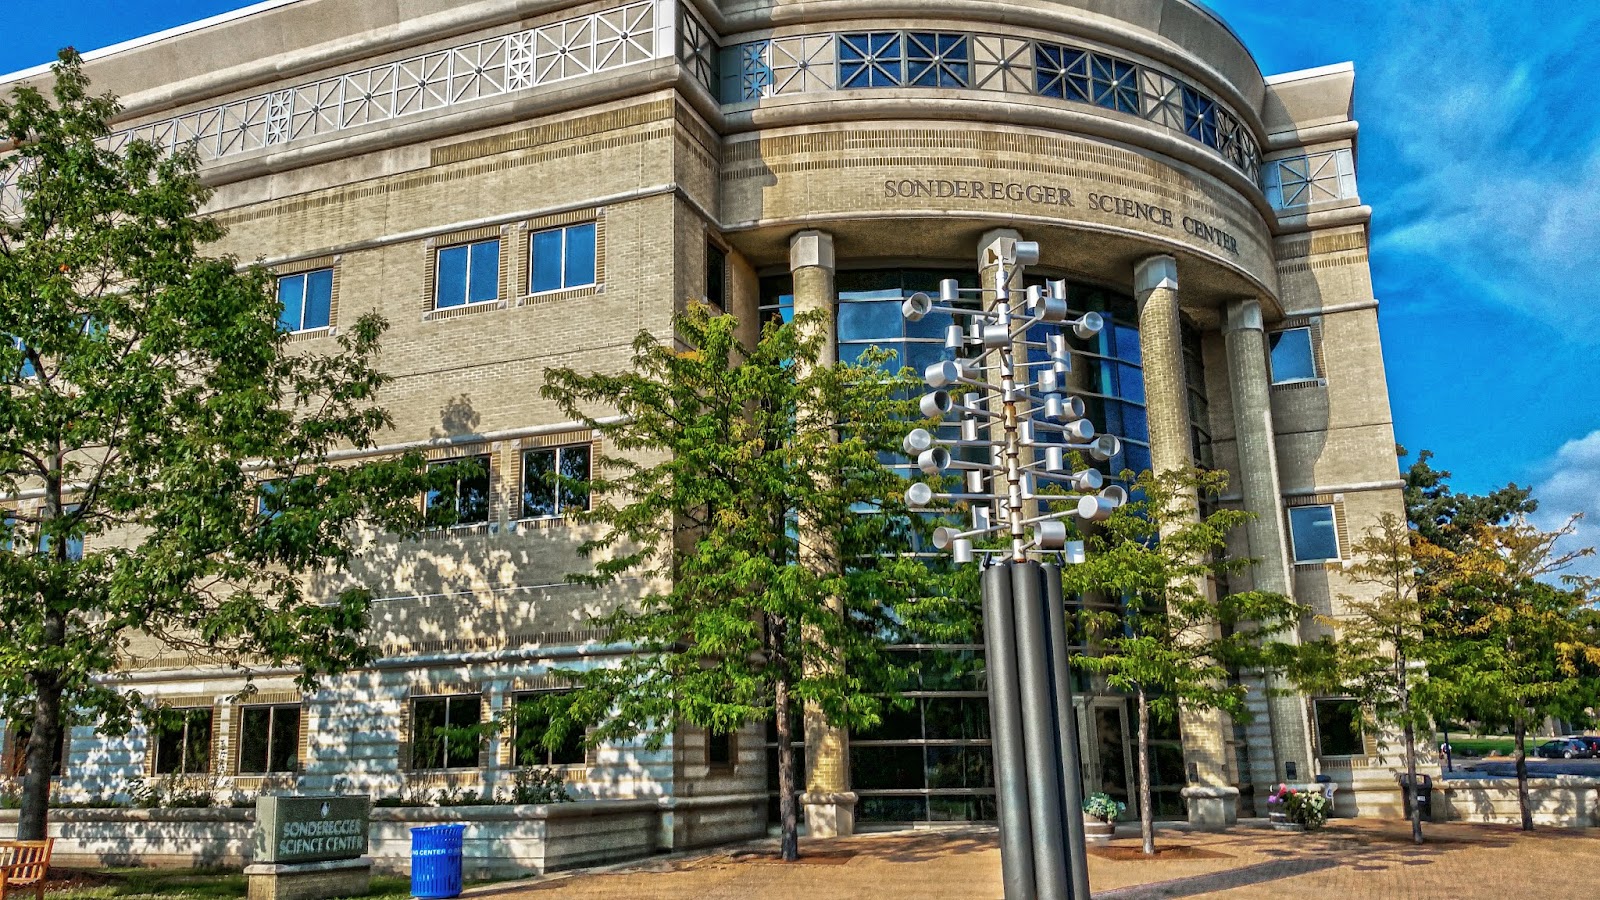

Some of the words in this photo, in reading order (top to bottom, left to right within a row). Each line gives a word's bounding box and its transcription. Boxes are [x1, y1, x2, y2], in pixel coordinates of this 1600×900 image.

[884, 179, 1075, 207] SONDEREGGER
[1088, 192, 1173, 228] SCIENCE
[1182, 216, 1239, 256] CENTER
[283, 819, 361, 838] SONDEREGGER
[279, 838, 324, 855] SCIENCE
[325, 835, 364, 852] CENTER
